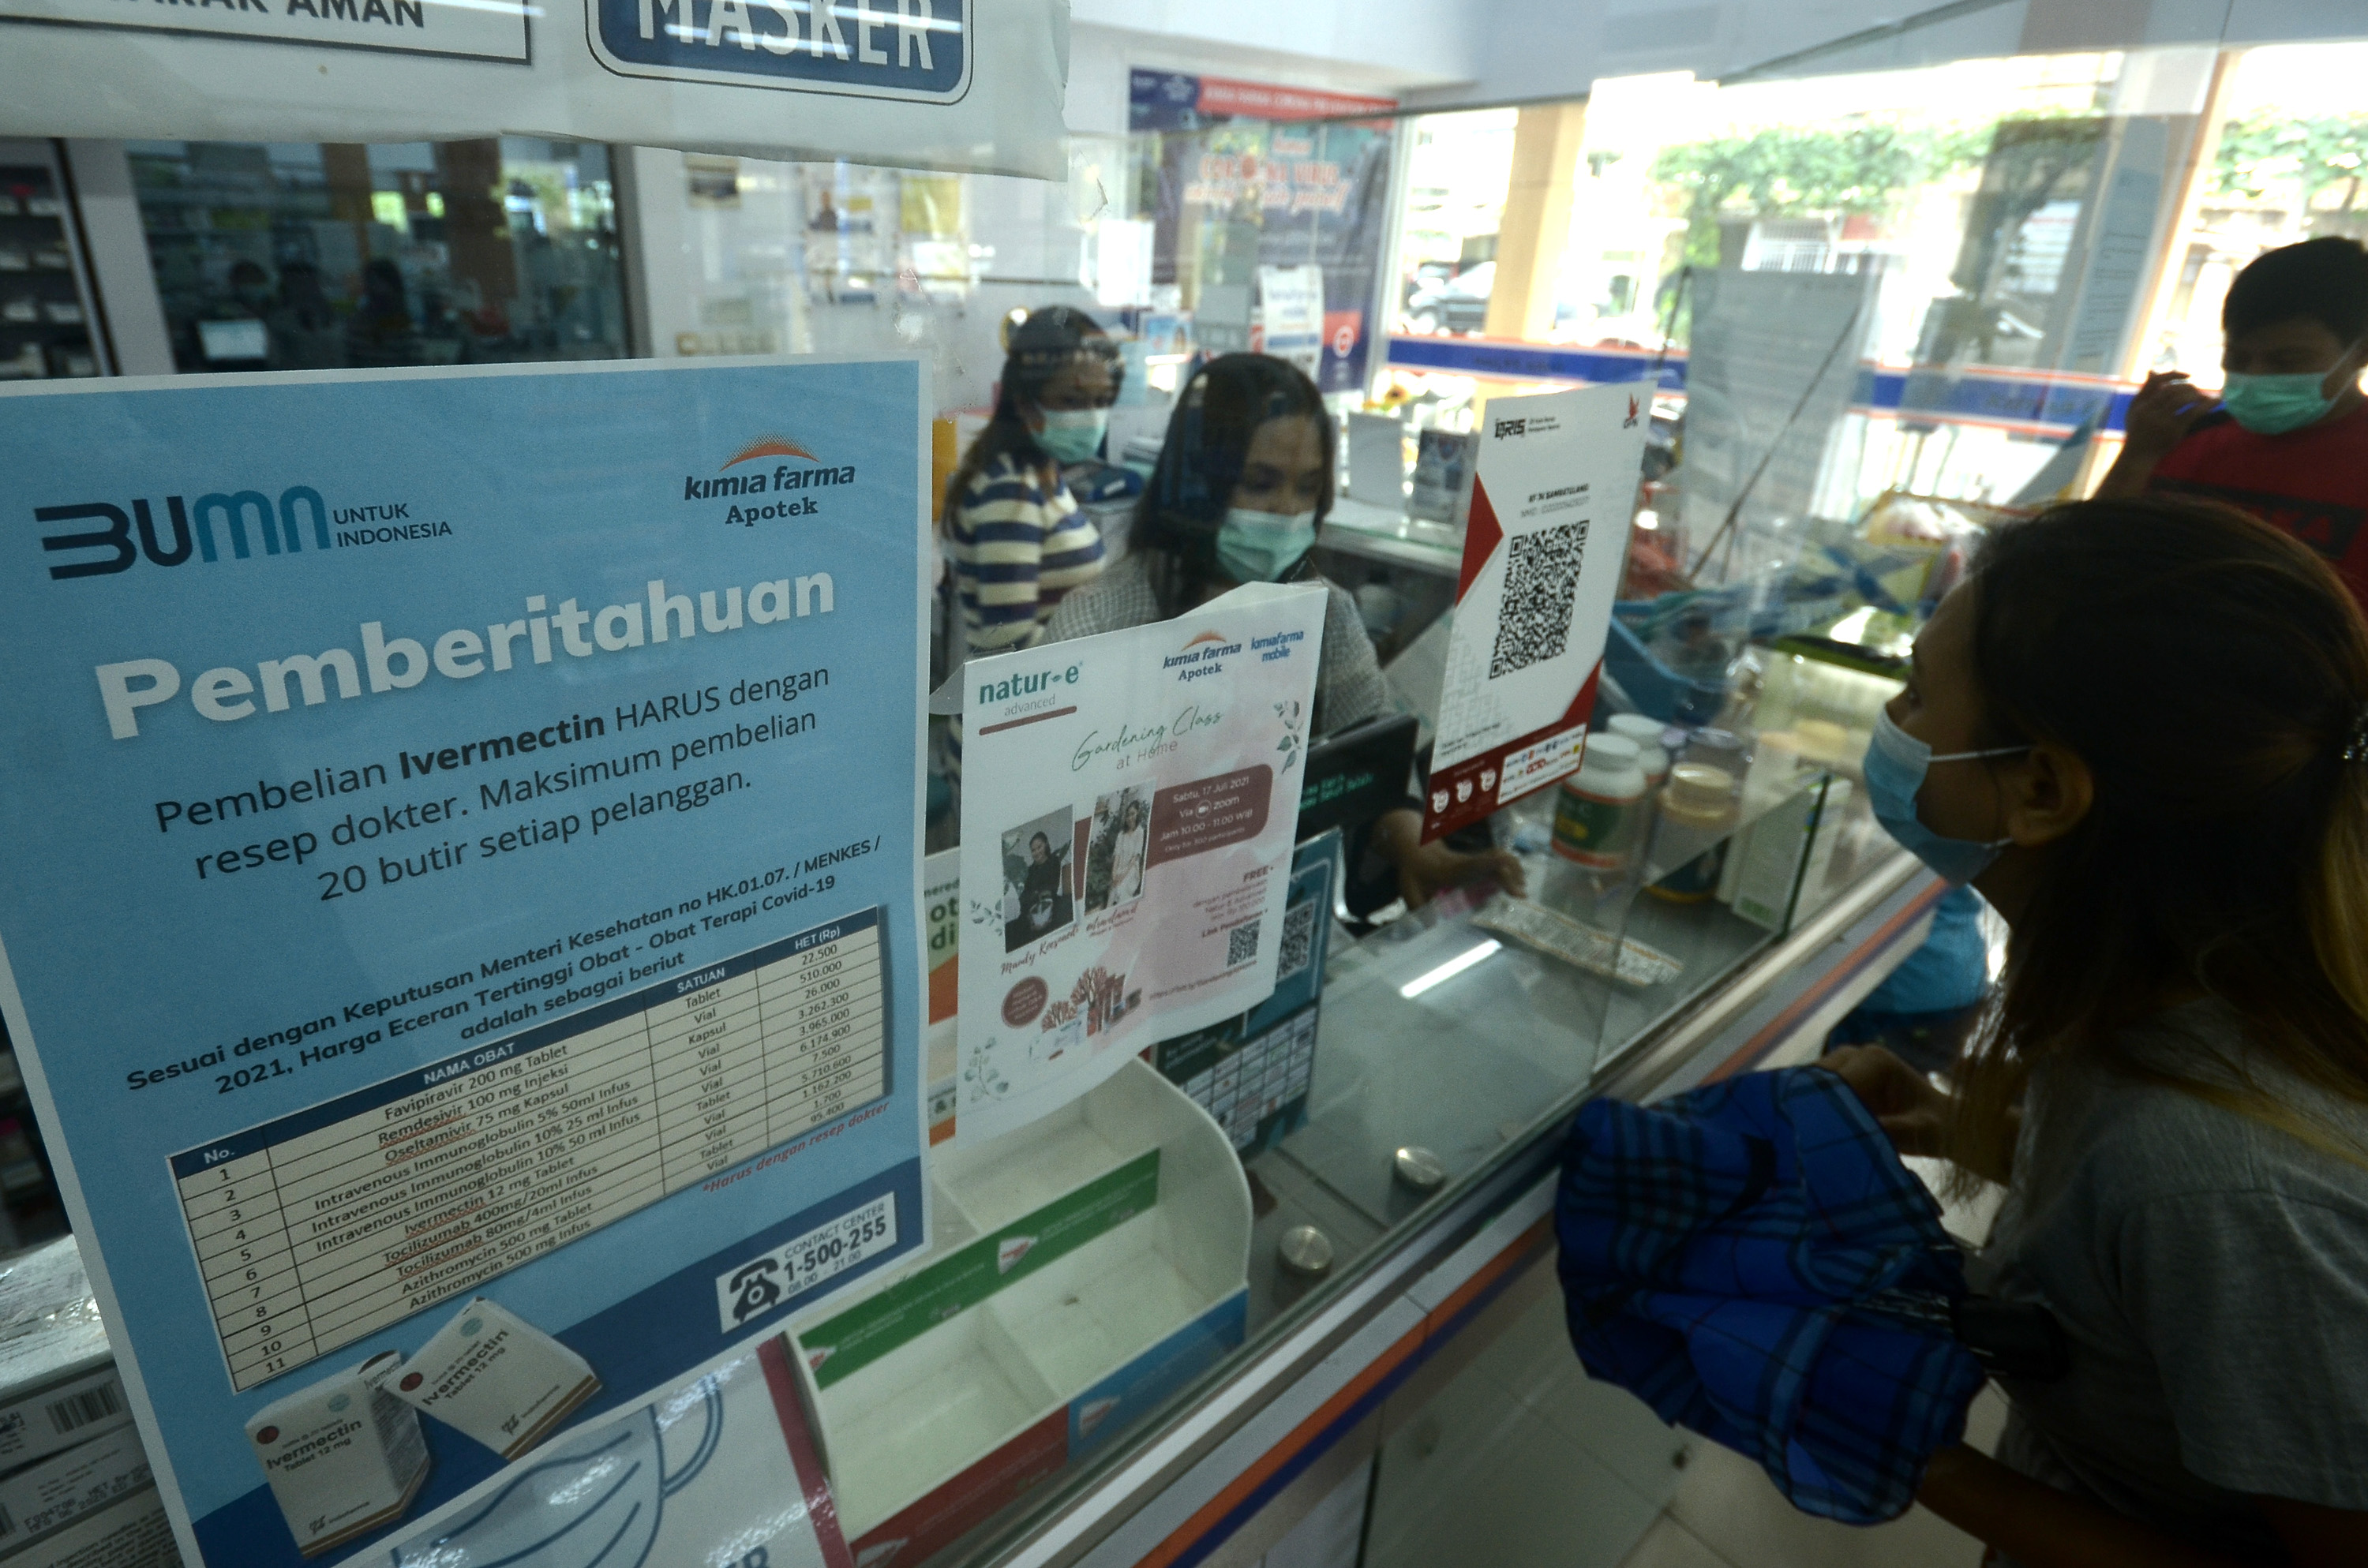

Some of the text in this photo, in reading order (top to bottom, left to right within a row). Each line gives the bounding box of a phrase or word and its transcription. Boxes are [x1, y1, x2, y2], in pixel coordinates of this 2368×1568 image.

[684, 466, 856, 500] kimia farma
[333, 503, 409, 524] UNTUK
[725, 497, 819, 526] Apotek
[34, 485, 331, 580] BUMN
[337, 521, 452, 548] INDONESIA
[95, 572, 834, 739] Pemberitahuan
[1163, 642, 1242, 670] kimia farma
[1261, 646, 1291, 664] mobile
[1178, 662, 1223, 683] Apotek
[1004, 694, 1056, 717] advanced
[155, 668, 830, 833] Pembelian Ivermectin HARUS dengan
[1072, 705, 1225, 772] Gardening Class
[1116, 739, 1178, 771] at Home
[196, 712, 816, 879] resep dokter. Maksimum pembelian
[1173, 776, 1250, 803] Sabtu, 17 Juli 2021
[1179, 795, 1239, 818] Via zoom
[317, 770, 751, 901] 20 butir setiap pelanggan.
[1160, 829, 1178, 841] Jam
[1236, 808, 1253, 820] WIB
[795, 926, 841, 949] HET (Rp)
[127, 840, 871, 1090] Sesuai dengan Keputusan Menteri Kesehatan no HK.01.07. MENKES
[802, 944, 837, 965] 22.500
[215, 875, 835, 1094] 2021, Harga Eceran Tertinggi Obat Obat Terapi Covid-19
[677, 967, 725, 993] SATUAN
[800, 960, 841, 983] 510.000
[461, 952, 684, 1040] adalah sebagai beriut
[686, 989, 720, 1009] Tablet
[805, 979, 840, 998] 26.000
[695, 1008, 716, 1024] Vial
[799, 993, 849, 1019] 3.262.300
[688, 1022, 726, 1045] Kapsul
[423, 1043, 515, 1084] NAMA OBAT
[699, 1043, 720, 1058] Vial
[812, 1044, 841, 1062] 7.500
[700, 1060, 721, 1076] Vial
[384, 1045, 568, 1121] Favipiravir 200 mg Tablet
[702, 1076, 722, 1093] Vial
[378, 1065, 568, 1144] Remdesivir 100 mg Injeksi
[697, 1091, 730, 1110] Tablet
[385, 1083, 568, 1162] Oseltamivir 75 mg Kapsul
[704, 1109, 725, 1125] Vial
[315, 1080, 631, 1211] Intravenous Immunoglobulin 5% 50ml Infus
[706, 1125, 725, 1140] Vial
[756, 1141, 805, 1171] dengan
[809, 1122, 845, 1147] resep
[848, 1102, 890, 1128] dokter
[204, 1149, 234, 1164] No.
[701, 1140, 733, 1158] Tablet
[707, 1155, 728, 1170] Vial
[311, 1096, 639, 1233] Intravenous Immunoglobulin 10% 25 Infus
[316, 1113, 640, 1252] Intravenous Immunoglobulin 10% 50 Infus
[404, 1156, 575, 1234] Ivermectin 12 mg Tablet
[384, 1166, 598, 1263] Tocilizumab 400mg/20ml Infus
[396, 1188, 591, 1277] Tocilizumab 80mg/4ml Infus
[785, 1203, 885, 1259] CONTACT CENTER
[242, 1248, 251, 1261] 5
[402, 1203, 592, 1294] Azithromycin 500 mg Tablet
[783, 1215, 886, 1281] 1-500-255
[834, 1250, 862, 1271] 21.00
[246, 1268, 257, 1281] 6
[410, 1221, 590, 1308] Azithromycin 500 mg Infus
[251, 1287, 260, 1298] 7
[256, 1306, 267, 1317] 8
[260, 1325, 271, 1336] 9
[261, 1341, 282, 1357] 10
[266, 1357, 285, 1373] 11
[422, 1328, 510, 1407] Ivermectin
[444, 1372, 476, 1400] Tablet
[267, 1421, 362, 1469] Ivermectin
